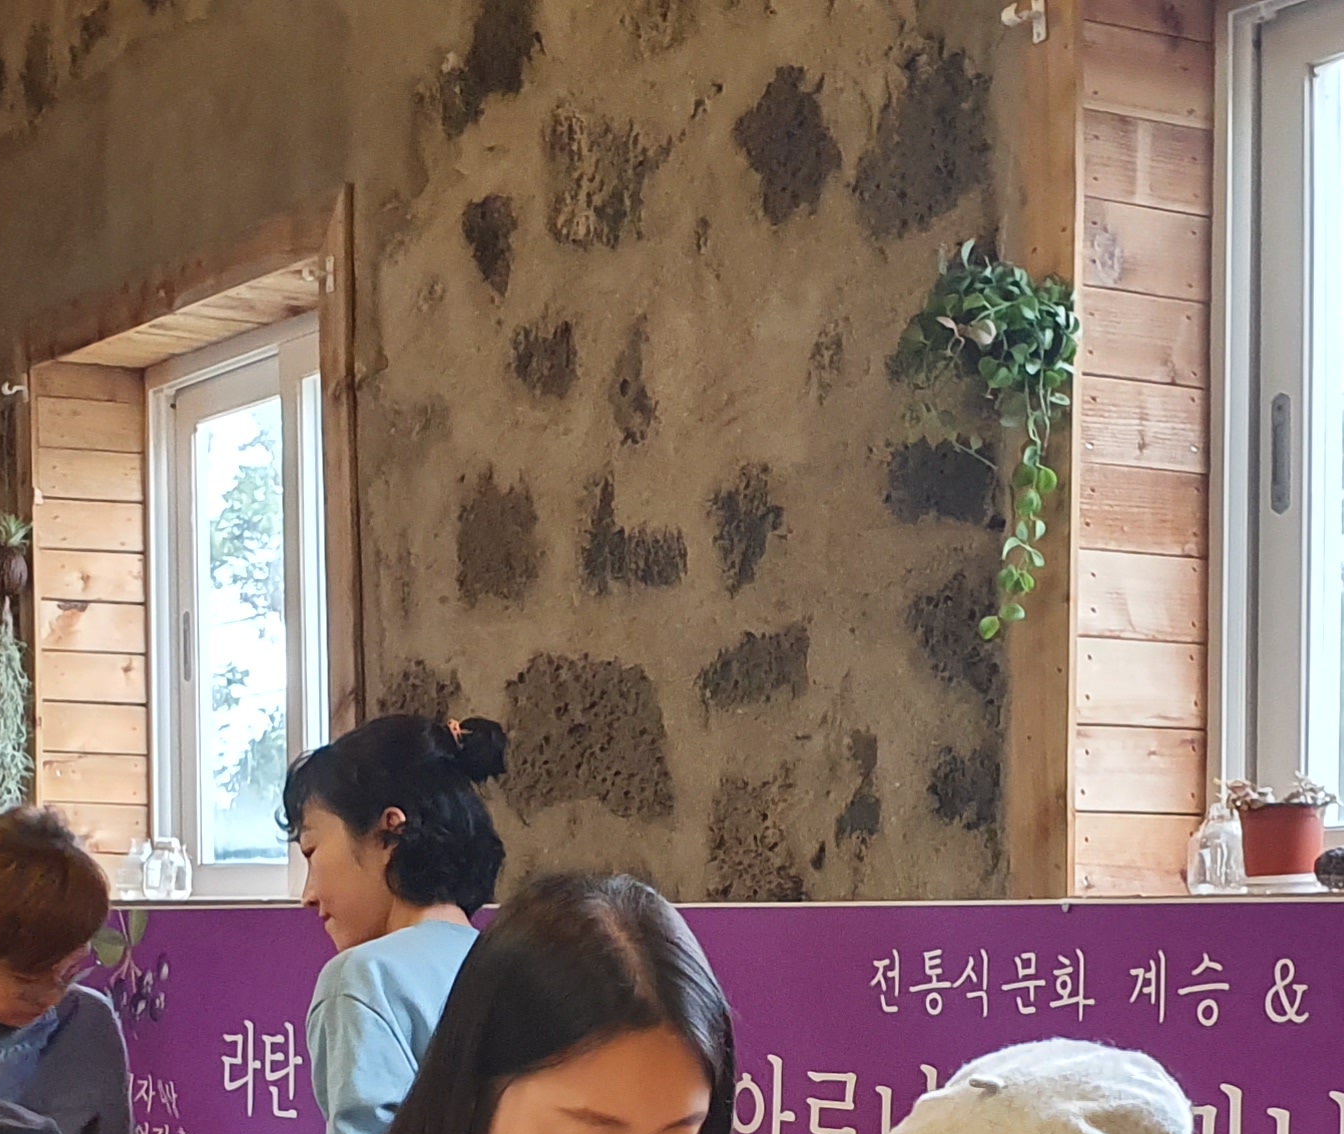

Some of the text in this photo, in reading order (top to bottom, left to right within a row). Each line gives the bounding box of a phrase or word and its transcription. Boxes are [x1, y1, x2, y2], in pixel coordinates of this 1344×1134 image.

[869, 948, 1095, 1022] 전통식문화
[1129, 950, 1230, 1027] 계승
[1264, 958, 1310, 1025] &
